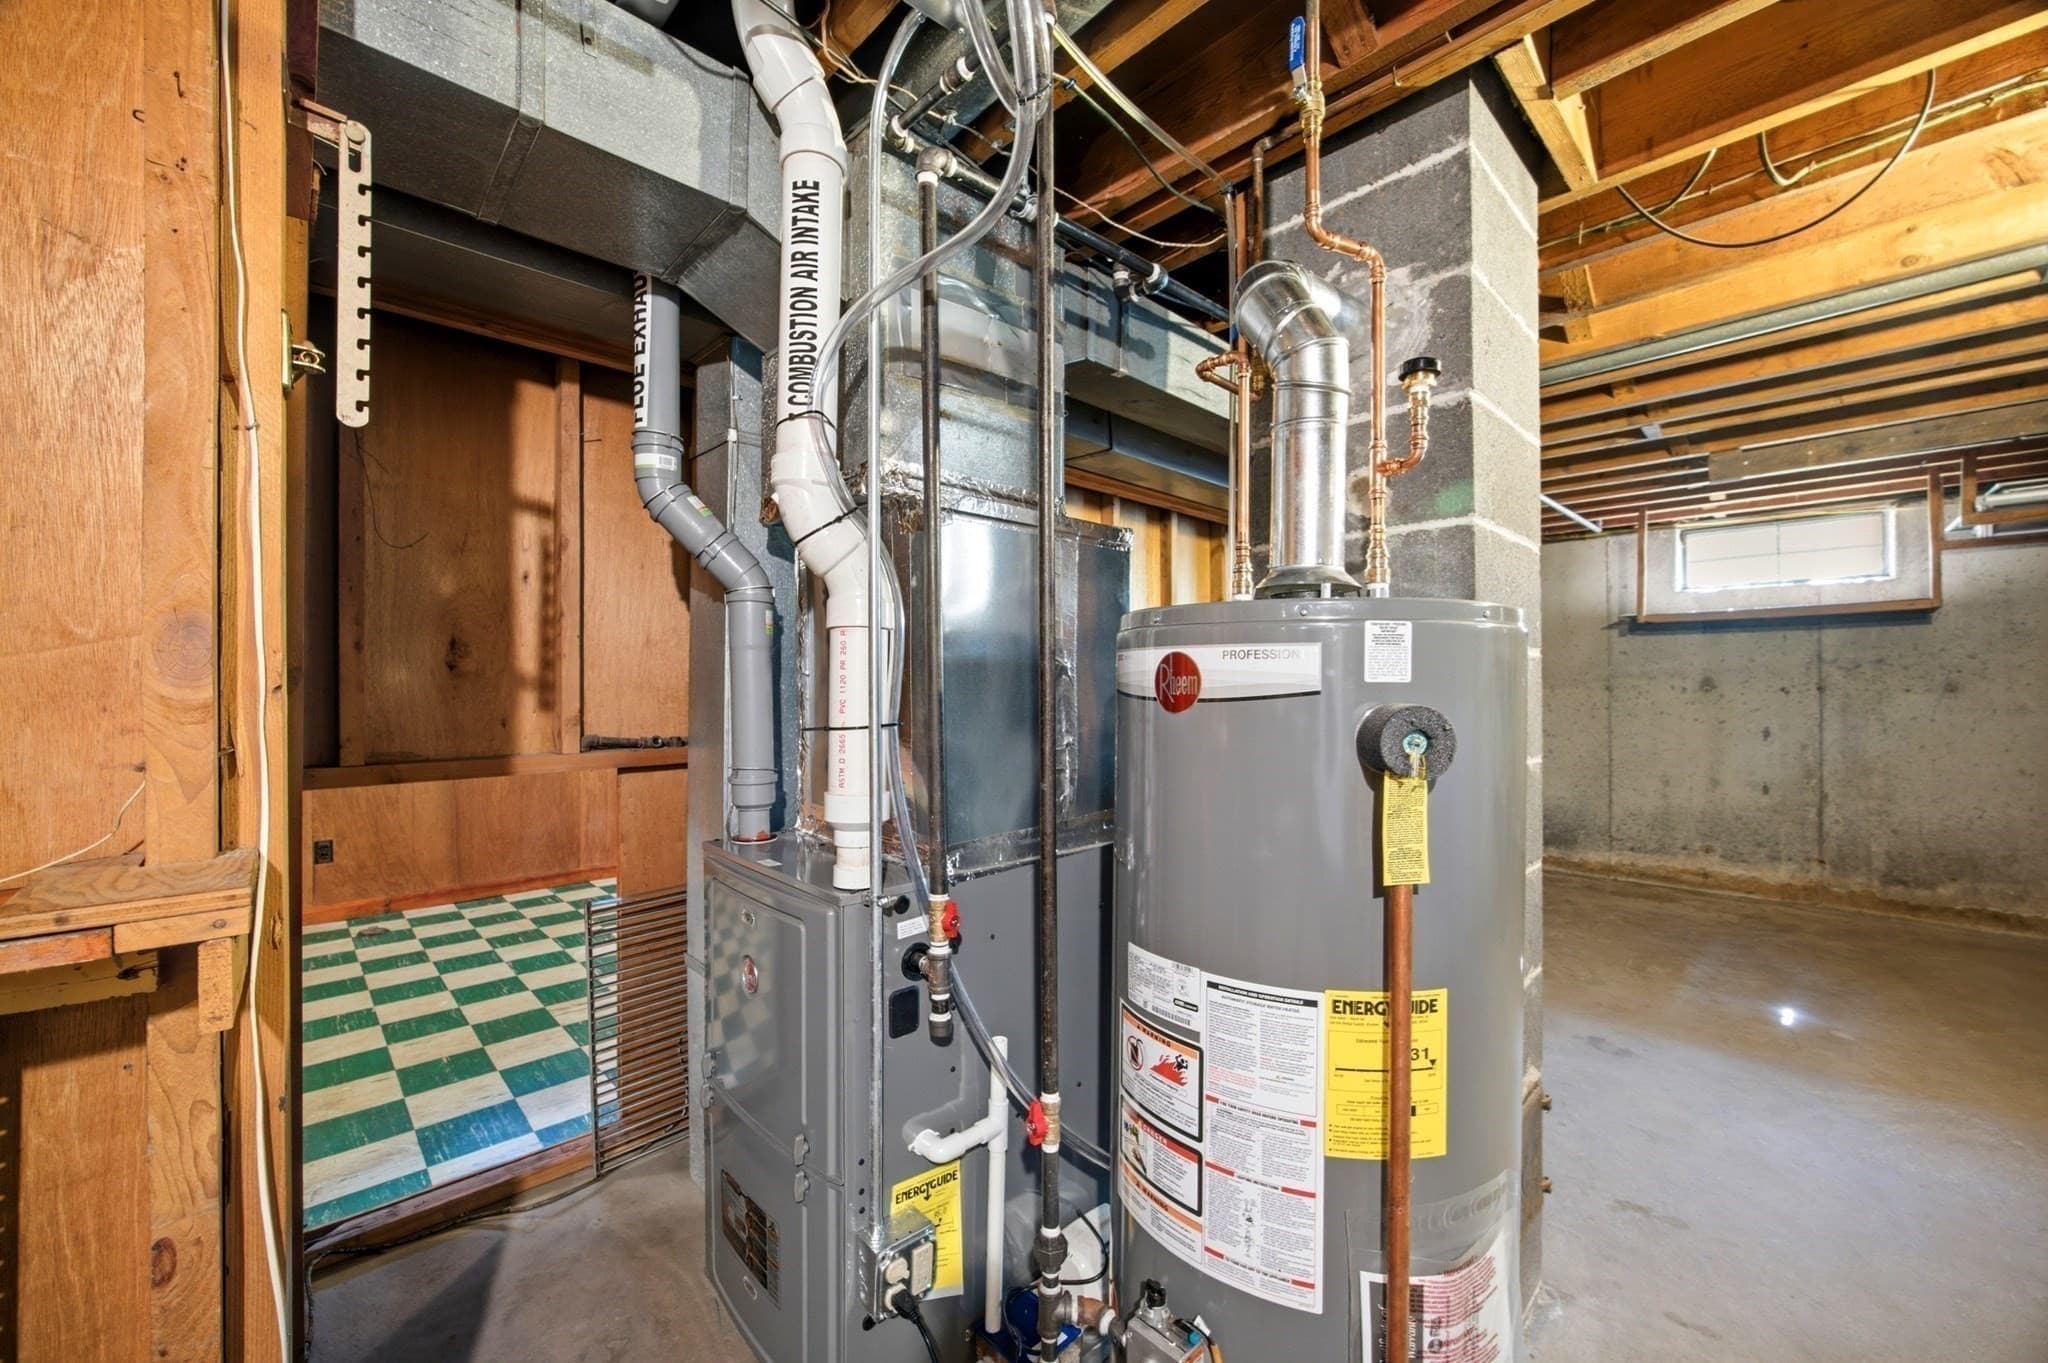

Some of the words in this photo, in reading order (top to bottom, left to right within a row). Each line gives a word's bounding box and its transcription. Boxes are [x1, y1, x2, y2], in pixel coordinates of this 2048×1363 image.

[791, 180, 820, 245] INTAKE
[790, 251, 819, 282] AIR
[633, 274, 648, 355] EXHAU
[787, 286, 818, 406] COMBUSTION
[839, 640, 848, 656] 260
[839, 674, 848, 694] 1120
[1160, 653, 1198, 703] Rheem
[839, 699, 847, 714] PVC
[838, 734, 847, 755] 2665
[1142, 1027, 1172, 1048] WARNING
[895, 1169, 959, 1205] ENERGYGUIDE
[1141, 1185, 1170, 1212] WARNING
